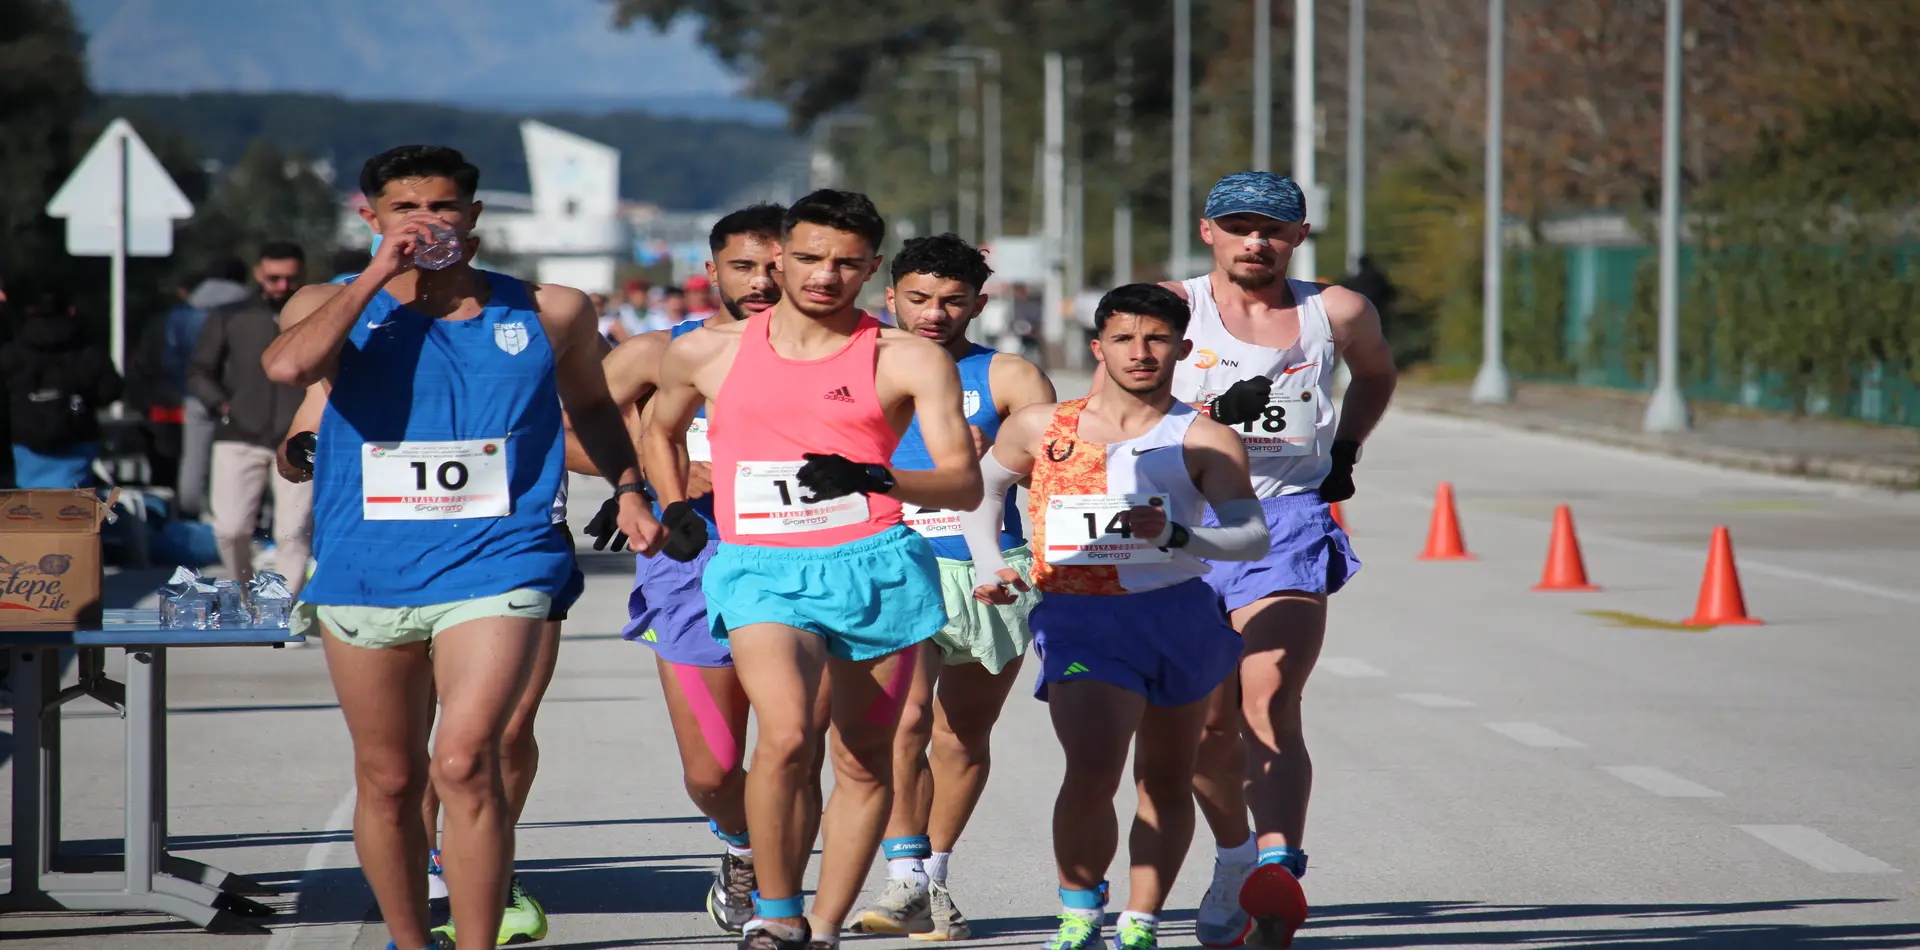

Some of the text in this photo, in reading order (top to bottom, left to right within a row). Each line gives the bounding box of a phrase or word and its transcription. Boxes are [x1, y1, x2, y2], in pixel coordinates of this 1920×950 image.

[1221, 359, 1239, 367] NN
[823, 394, 855, 404] adidas
[410, 460, 469, 491] 10
[1083, 510, 1131, 539] 14
[39, 594, 70, 611] Life
